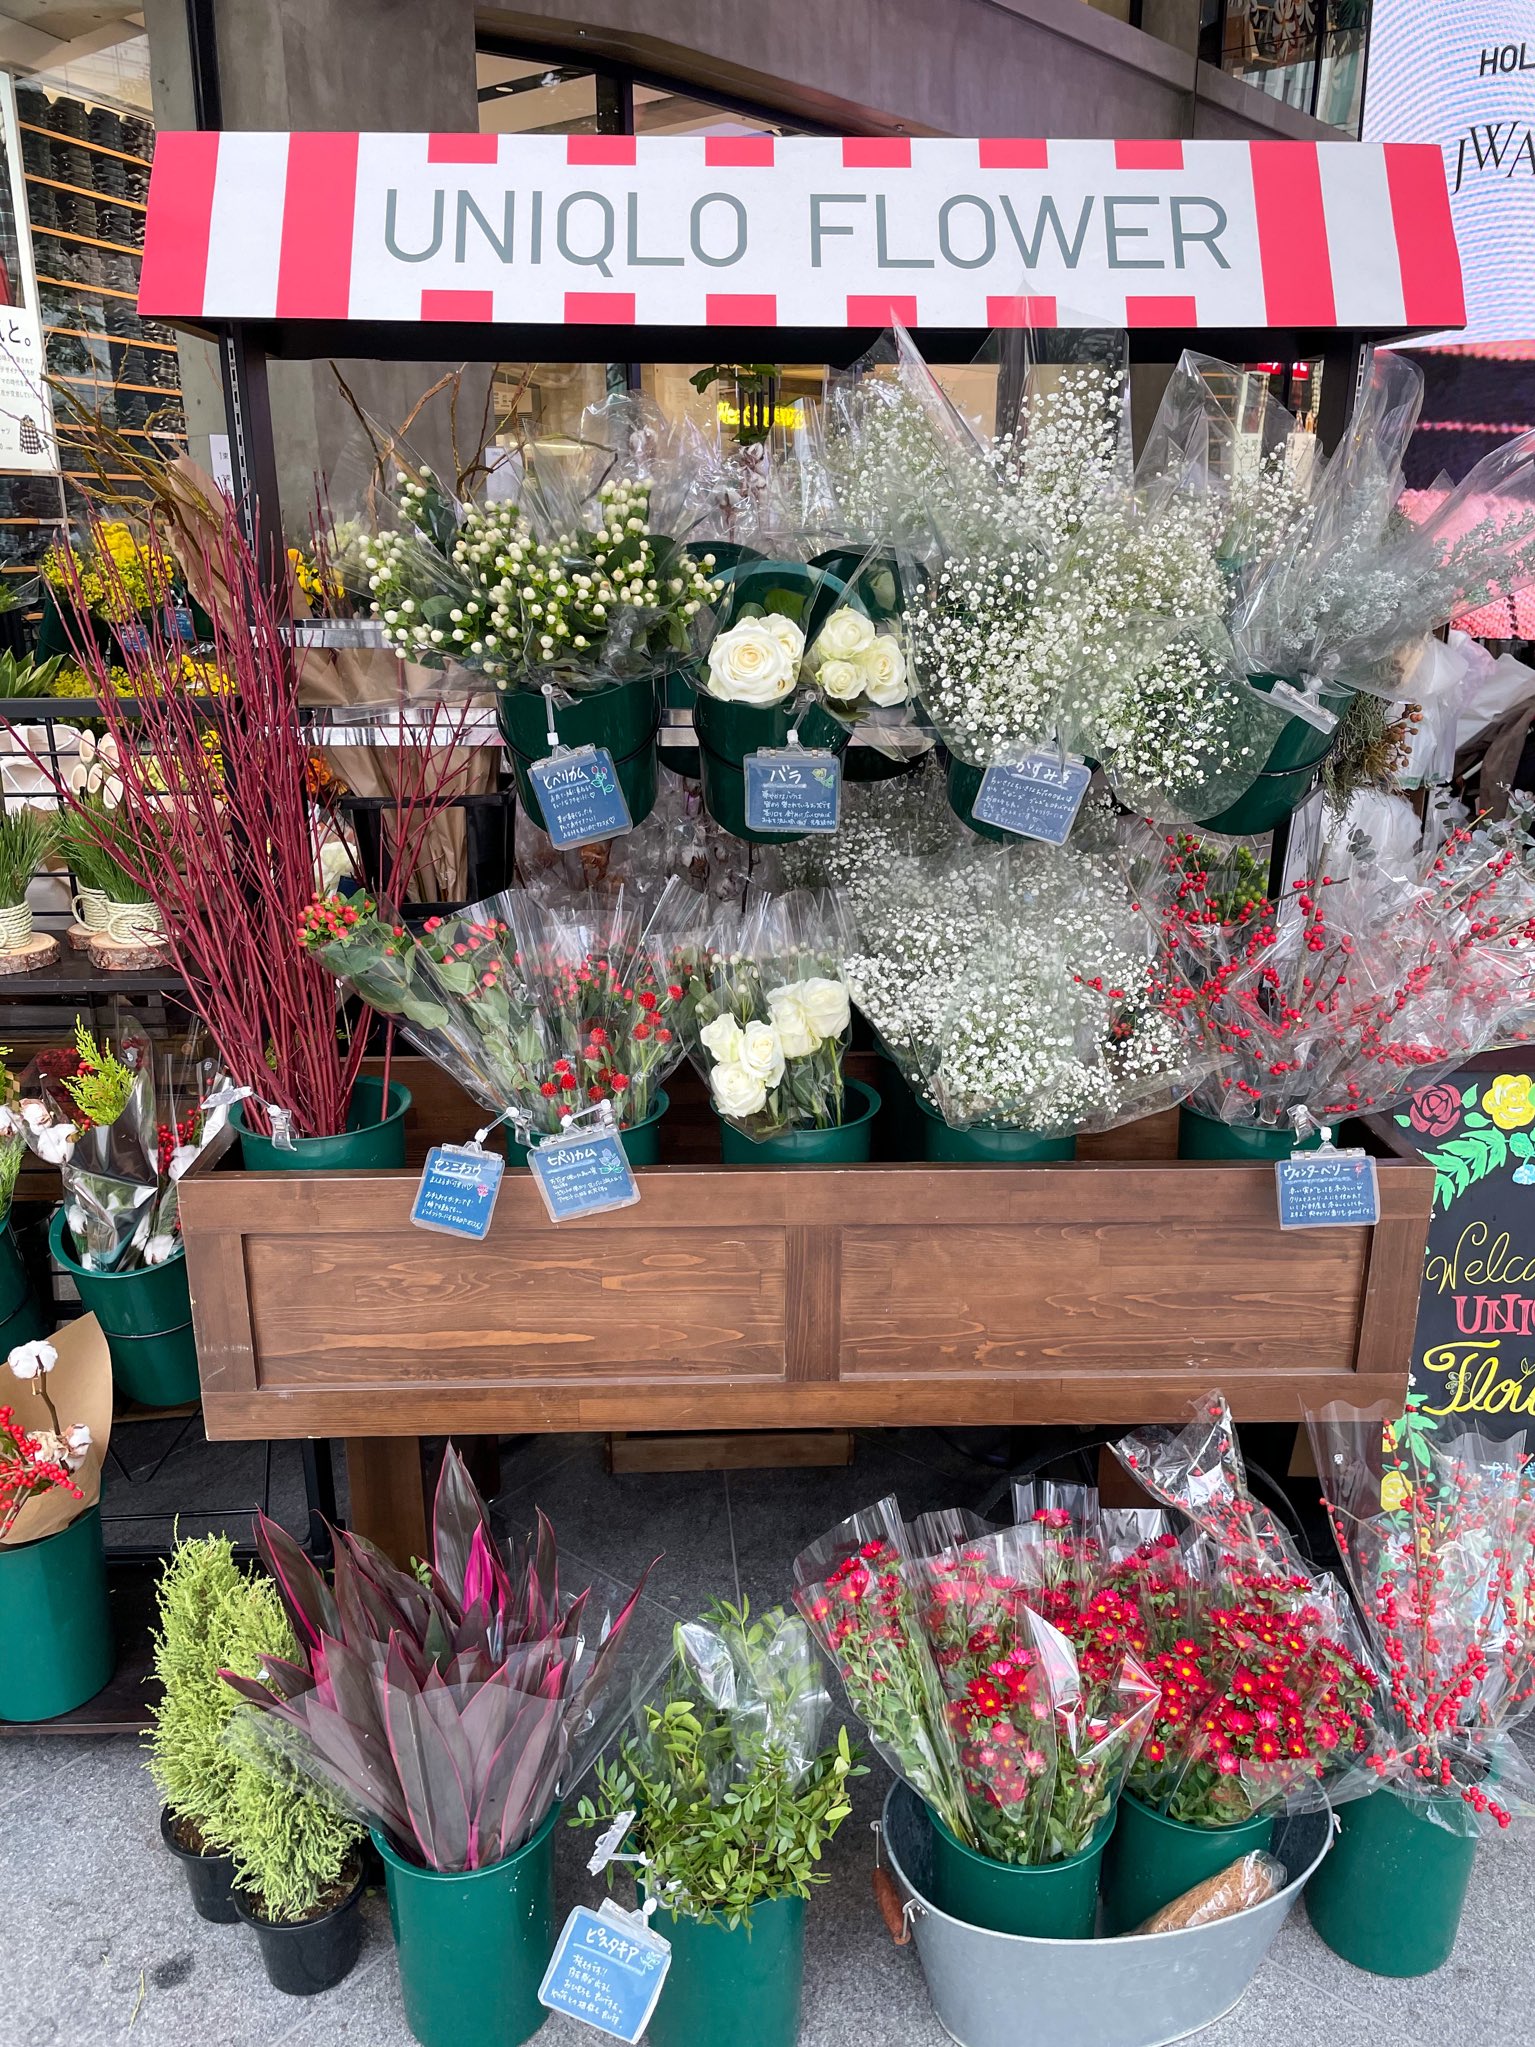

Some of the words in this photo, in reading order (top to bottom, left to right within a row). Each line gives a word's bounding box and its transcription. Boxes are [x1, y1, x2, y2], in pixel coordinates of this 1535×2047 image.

[384, 188, 748, 278] UNIQLO
[809, 193, 1232, 270] FLOWER
[769, 764, 802, 784] バラ
[1283, 1161, 1351, 1180] ウィンターベリー
[585, 1926, 639, 1963] ピスタキア
